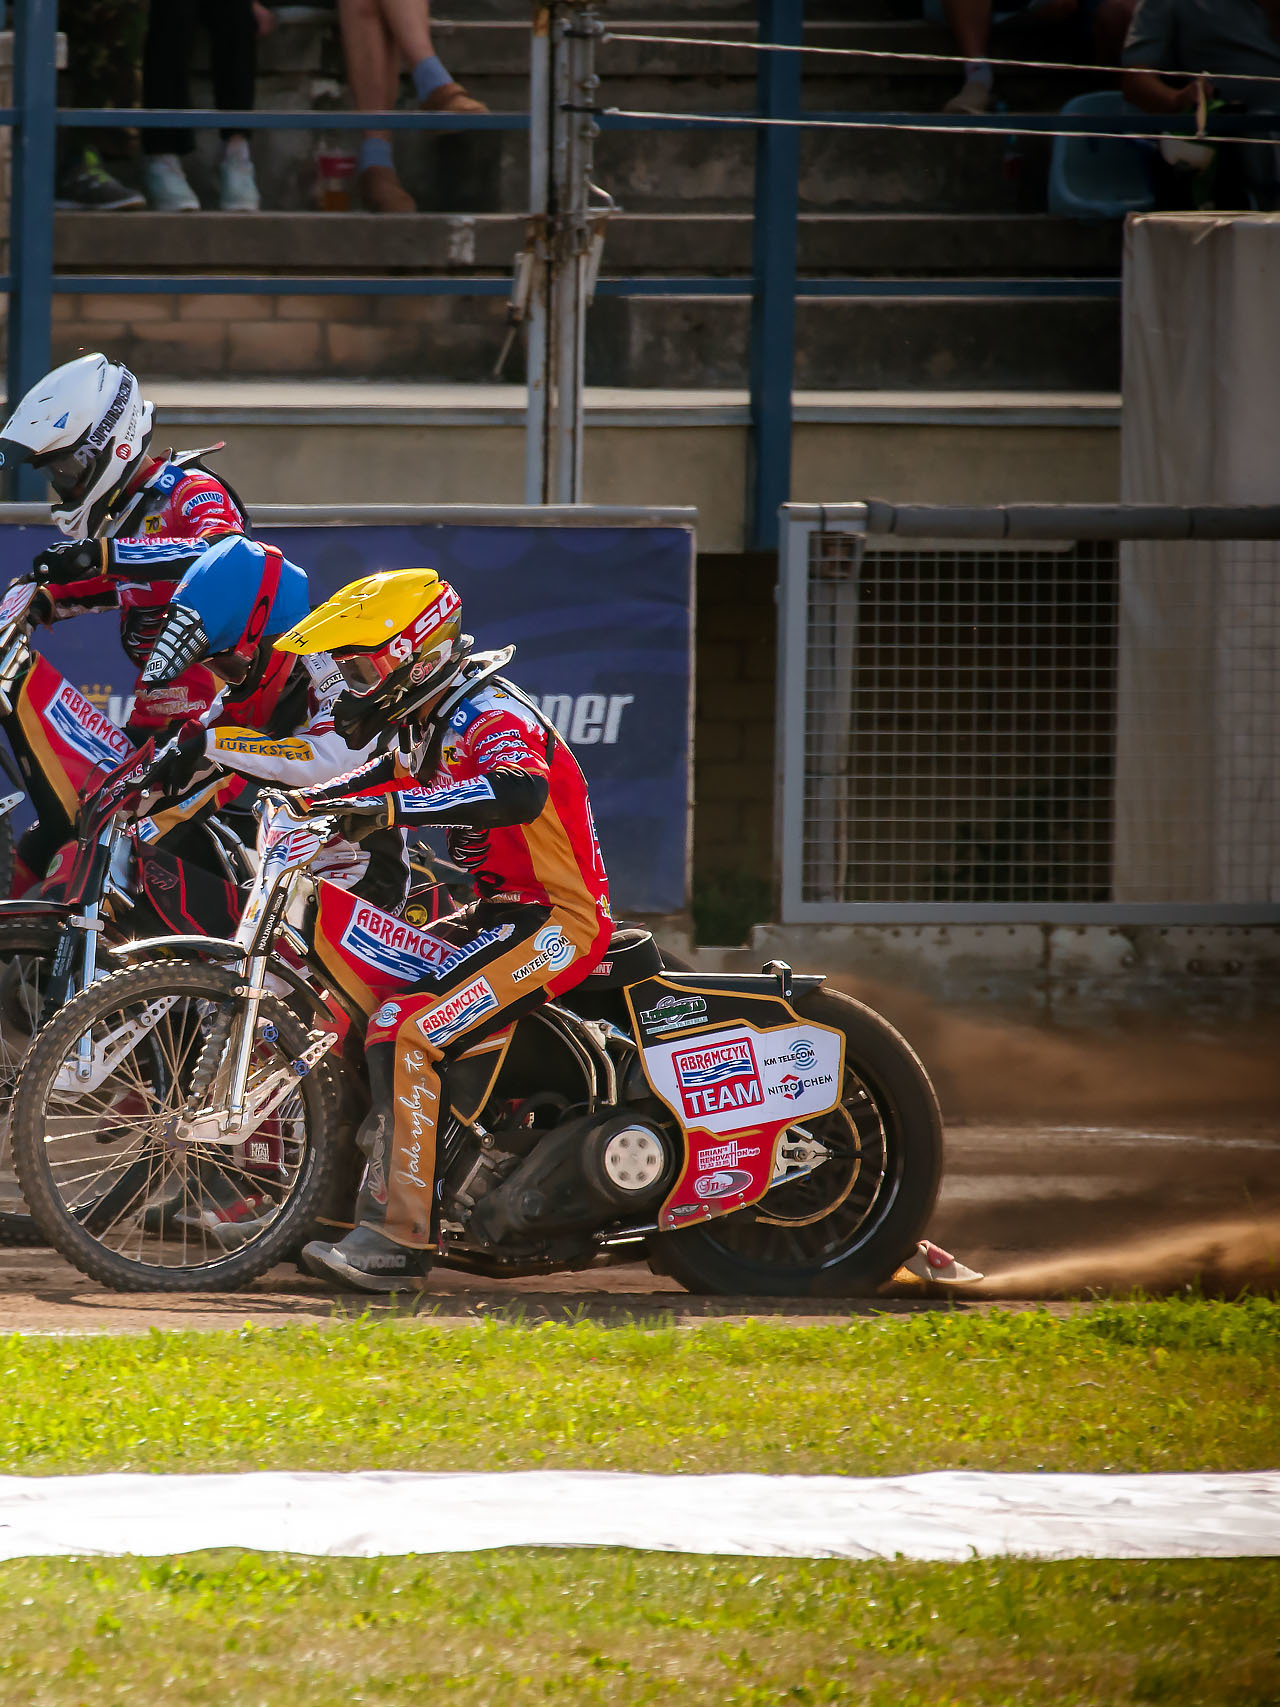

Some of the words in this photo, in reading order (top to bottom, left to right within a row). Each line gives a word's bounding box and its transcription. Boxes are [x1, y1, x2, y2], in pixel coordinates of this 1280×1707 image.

[59, 686, 138, 760] ABRAMCZY
[528, 693, 635, 745] ner
[356, 907, 454, 966] ABRAMCZY
[513, 966, 531, 983] KM
[528, 936, 570, 971] TELECOM
[422, 981, 489, 1034] ABRAMCZYK
[680, 1045, 749, 1072] ABRAMCZYK
[764, 1057, 777, 1067] KM
[778, 1049, 816, 1063] TELECOM
[685, 1079, 762, 1115] TEAM
